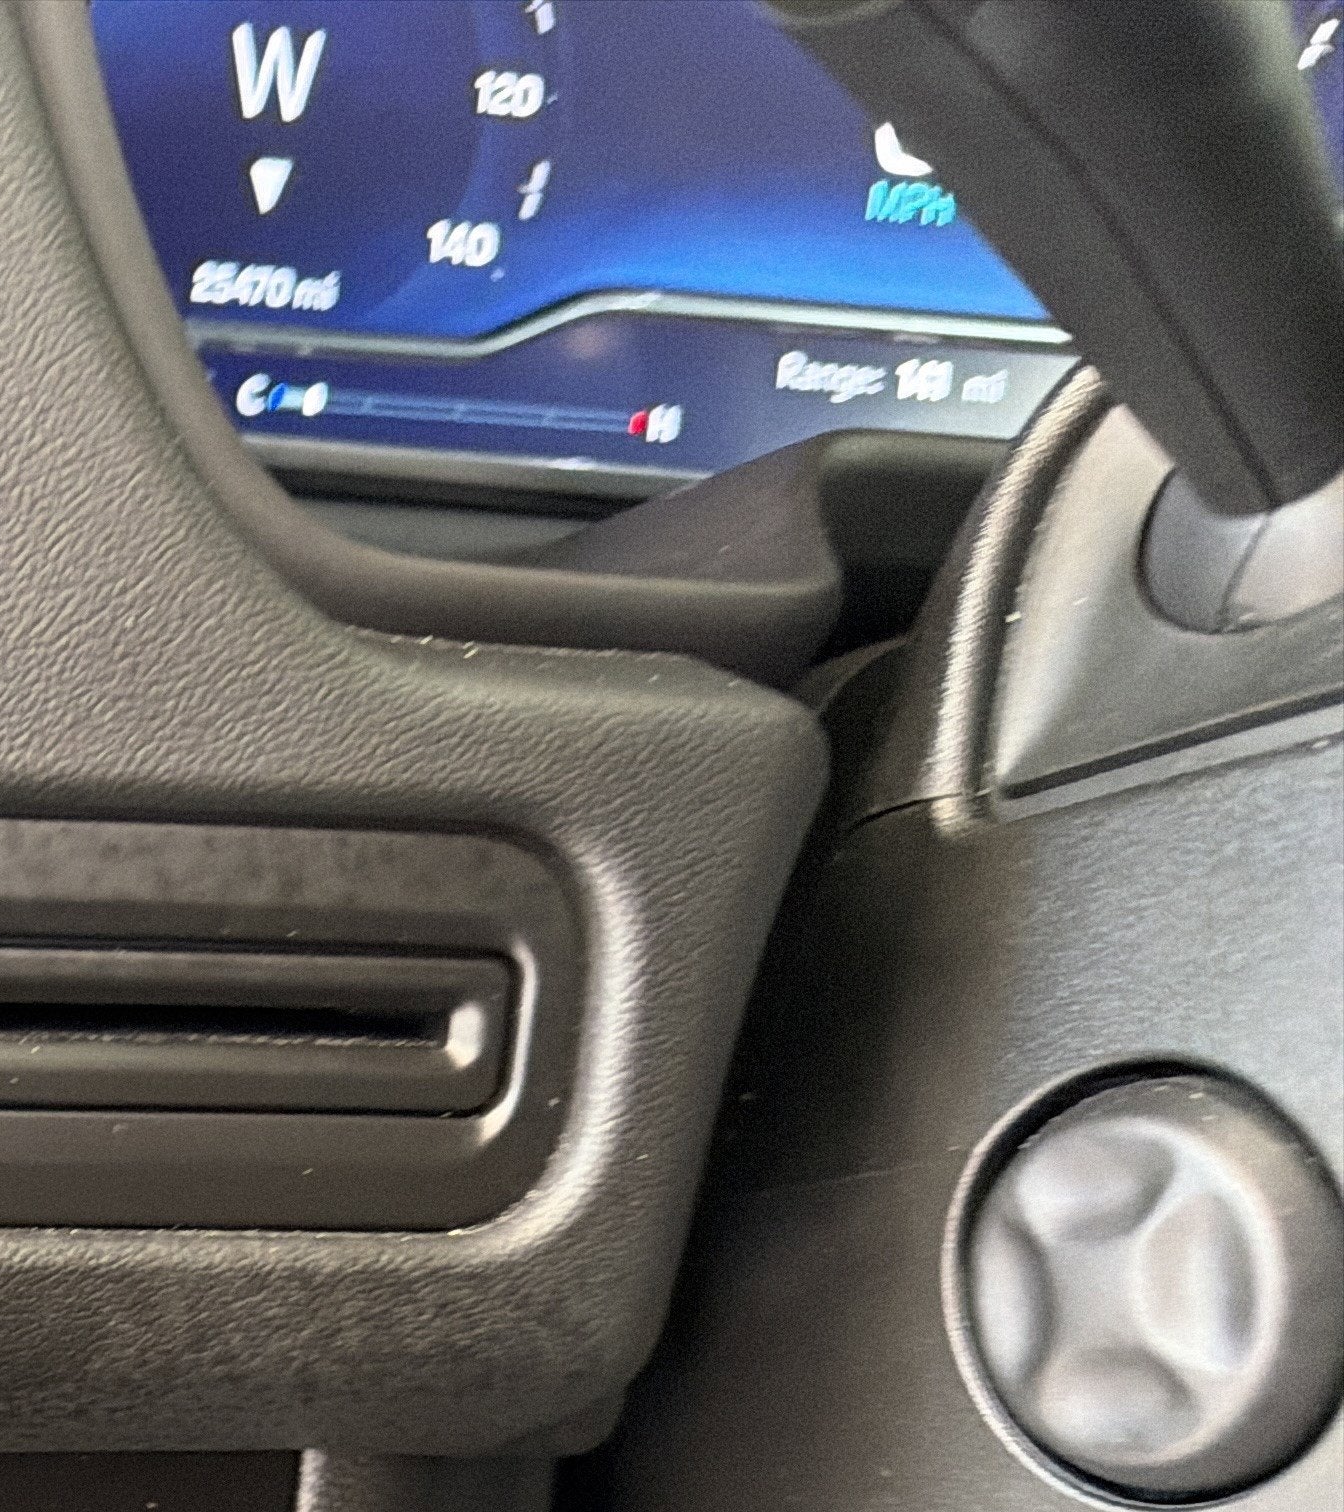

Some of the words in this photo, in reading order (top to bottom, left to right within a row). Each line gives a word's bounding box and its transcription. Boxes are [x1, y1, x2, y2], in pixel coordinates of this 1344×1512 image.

[232, 22, 326, 122] W
[474, 70, 545, 118] 120
[865, 179, 957, 227] MPH
[426, 218, 502, 268] 140
[291, 269, 342, 311] mi
[235, 372, 271, 417] C
[961, 369, 1008, 403] mi
[645, 402, 682, 443] H
